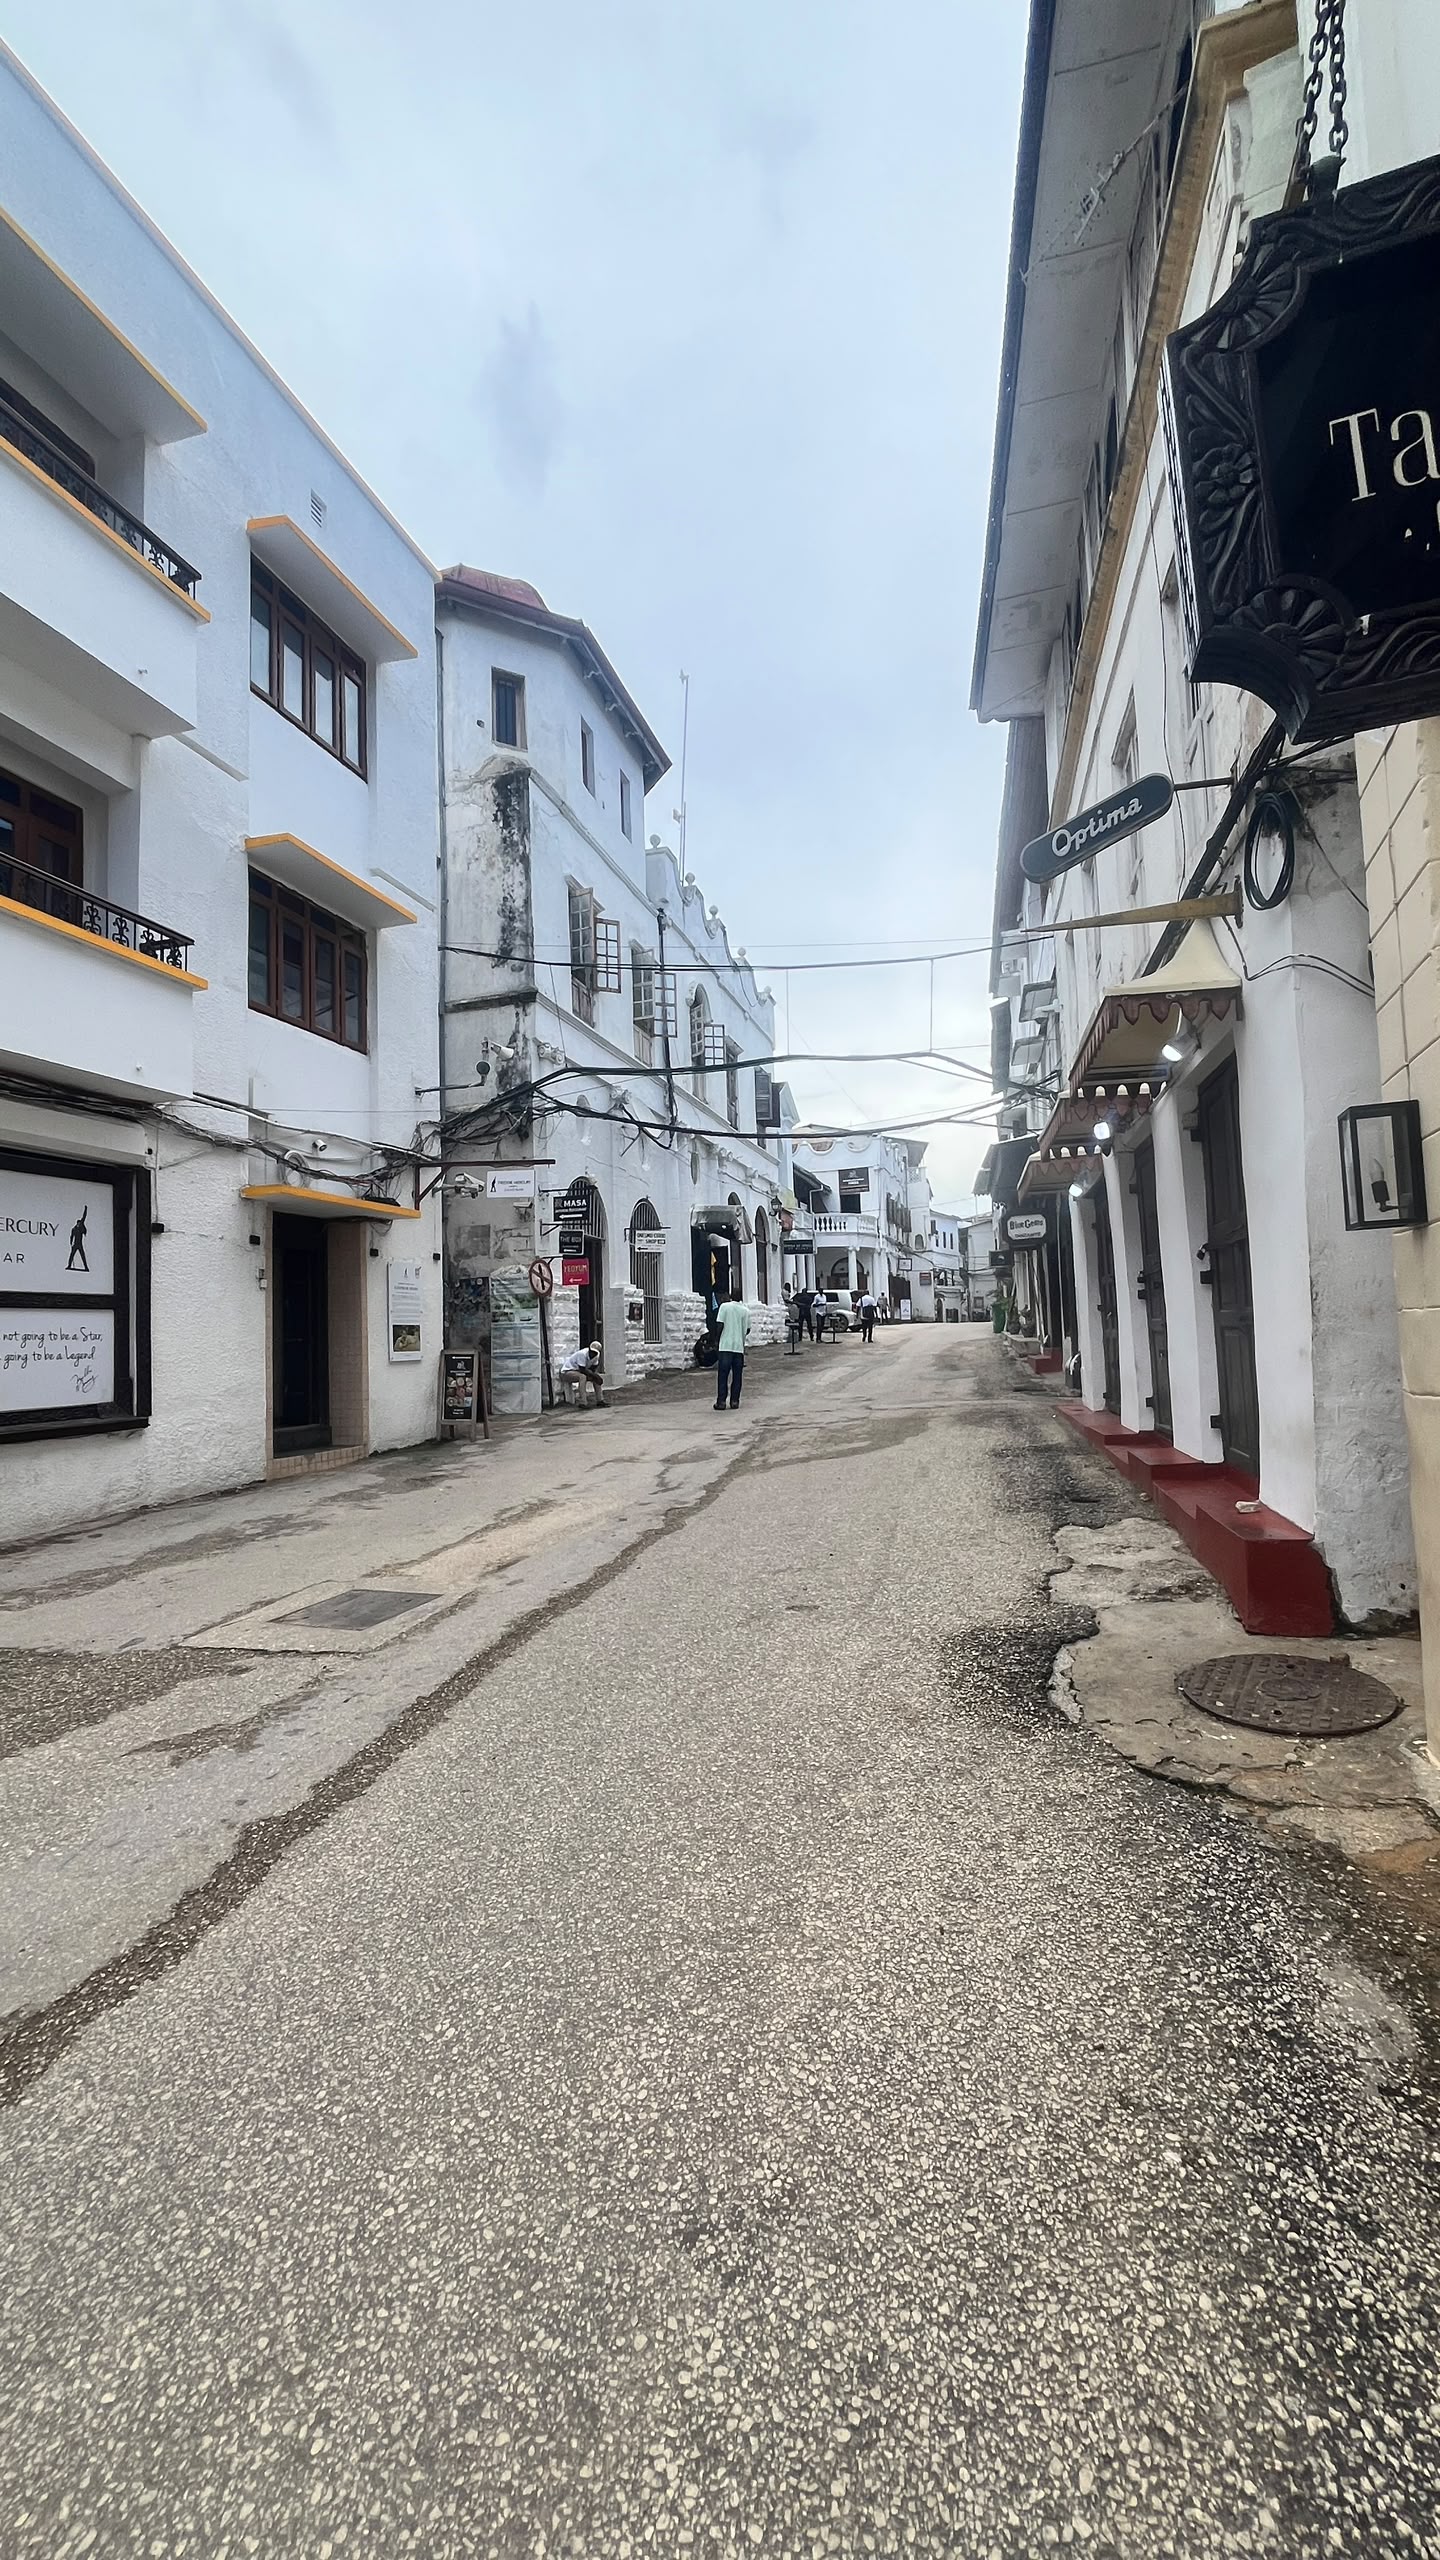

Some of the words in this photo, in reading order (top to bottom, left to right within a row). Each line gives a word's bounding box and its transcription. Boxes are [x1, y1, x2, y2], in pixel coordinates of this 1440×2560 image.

[1329, 408, 1440, 501] Ta
[1051, 797, 1143, 857] Optima
[563, 1199, 587, 1208] MASA
[3, 1331, 20, 1341] not
[20, 1333, 45, 1349] going
[48, 1331, 58, 1341] to
[59, 1327, 70, 1341] be
[71, 1333, 79, 1341] a
[3, 1352, 28, 1370] going
[32, 1351, 42, 1361] to
[43, 1346, 55, 1360] be
